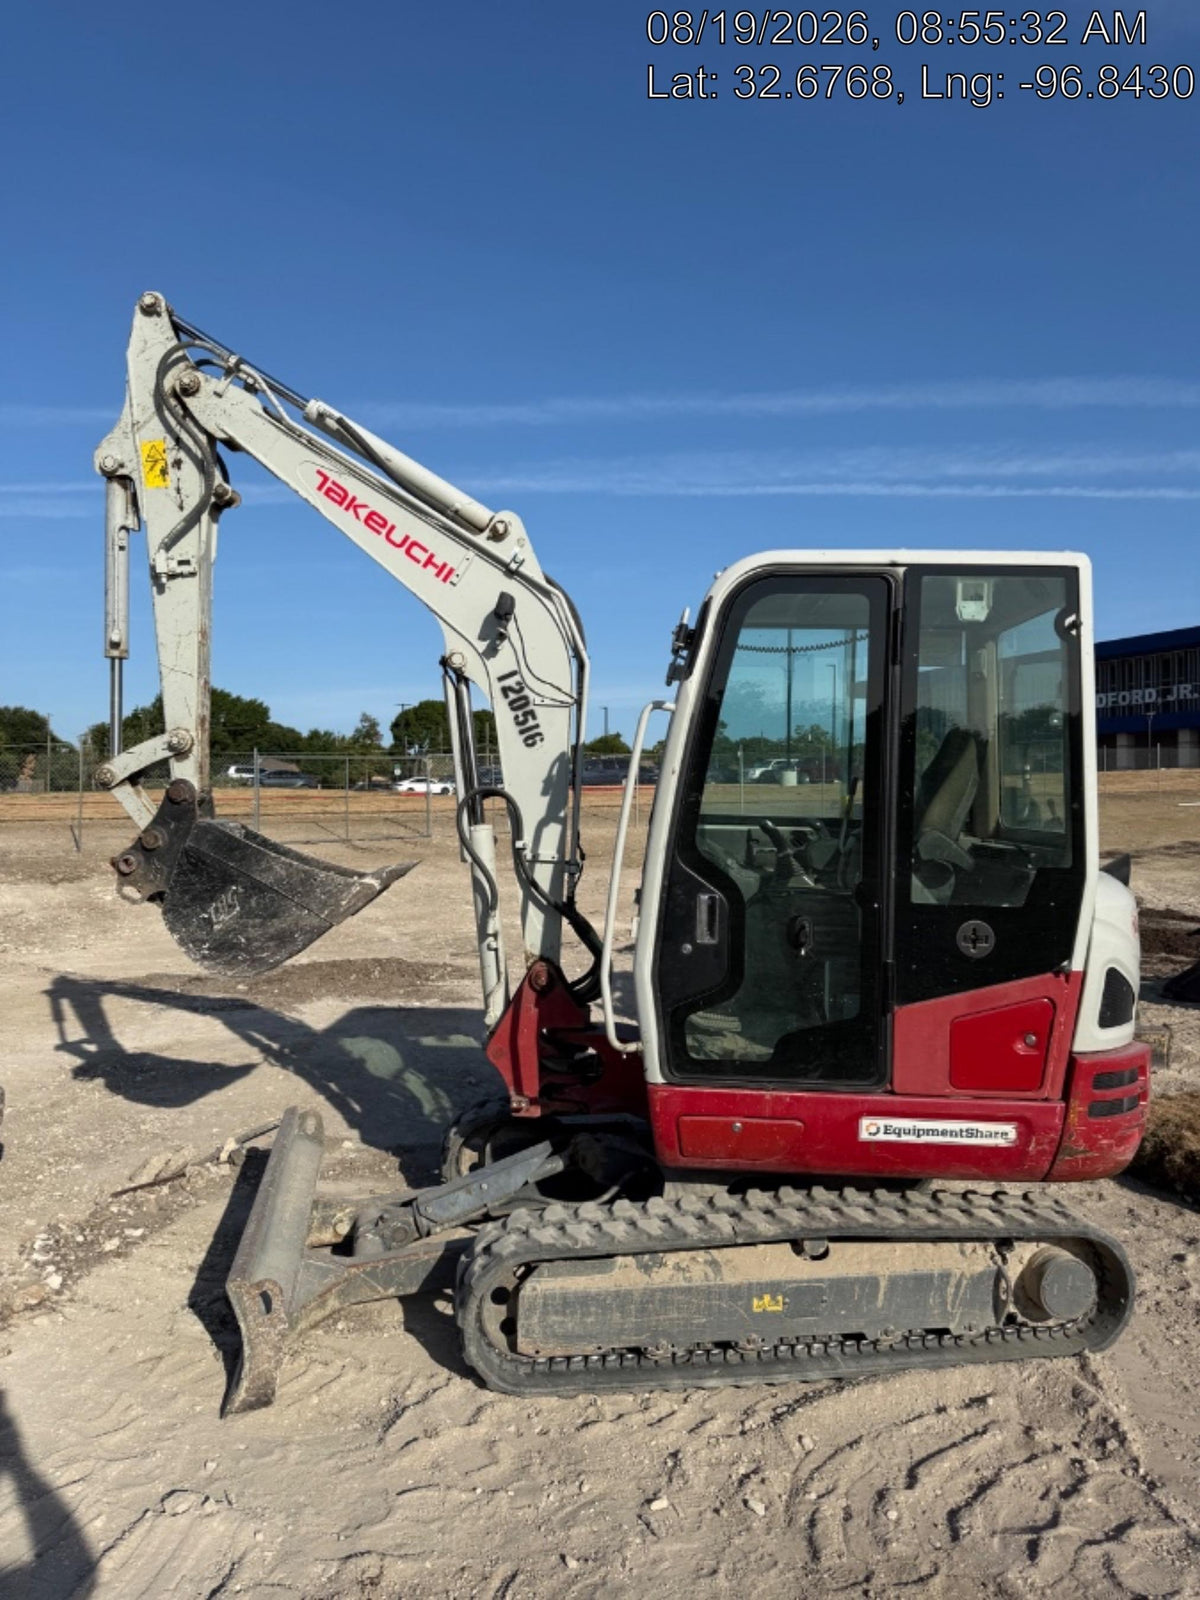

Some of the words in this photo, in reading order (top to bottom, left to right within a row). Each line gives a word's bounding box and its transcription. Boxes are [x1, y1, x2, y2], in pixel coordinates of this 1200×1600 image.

[1166, 683, 1200, 701] JR.
[496, 669, 544, 748] 120516
[882, 1124, 1010, 1140] EquipmentShare
